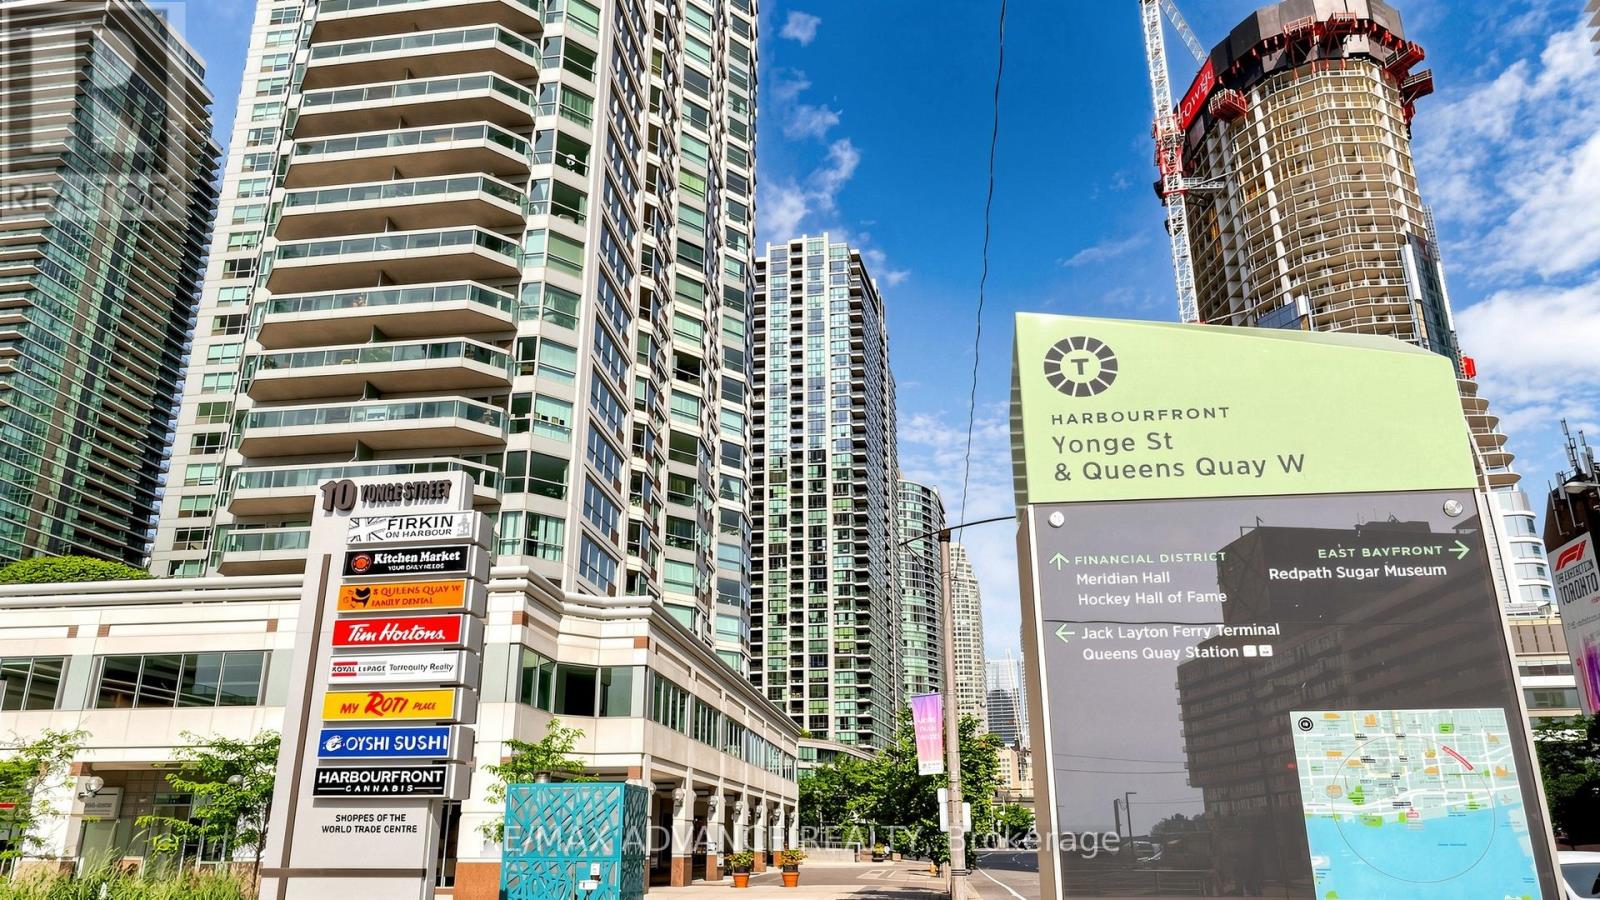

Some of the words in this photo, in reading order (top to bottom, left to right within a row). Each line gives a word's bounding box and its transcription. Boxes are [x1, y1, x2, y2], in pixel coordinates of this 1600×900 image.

[1051, 407, 1230, 425] HARBOURFRONT
[1052, 436, 1136, 456] Yonge
[1147, 432, 1174, 451] St
[1054, 463, 1072, 482] &
[1082, 461, 1185, 480] Queens
[1195, 456, 1266, 478] Quay
[1277, 454, 1305, 474] W
[320, 479, 357, 512] 10
[360, 482, 402, 503] YONGE
[403, 479, 452, 501] STREET
[387, 515, 454, 531] FIRKIN
[385, 531, 400, 539] ON
[402, 528, 452, 538] HARBOUR
[373, 552, 418, 565] Kitchen
[420, 550, 461, 563] Market
[1074, 554, 1155, 565] FINANCIAL
[1159, 551, 1227, 563] DISTRICT
[1317, 548, 1356, 559] EAST
[1361, 545, 1443, 557] BAYFRONT
[1076, 573, 1139, 585] Meridian
[1142, 571, 1170, 584] Hall
[1268, 566, 1333, 581] Redpath
[1336, 565, 1380, 580] Sugar
[1384, 564, 1448, 577] Museum
[381, 586, 420, 597] QUEENS
[422, 584, 449, 595] QUAY
[1559, 572, 1599, 604] TORONTO
[372, 598, 400, 607] FAMILY
[402, 597, 433, 606] DENTAL
[1078, 593, 1131, 607] Hockey
[1135, 592, 1164, 604] Hall
[1167, 592, 1183, 604] of
[1187, 590, 1228, 603] Fame
[348, 623, 377, 642] Tim
[1081, 626, 1114, 640] Jack
[1118, 625, 1169, 641] Layton
[1173, 625, 1212, 641] Ferry
[1216, 623, 1281, 637] Terminal
[1082, 649, 1138, 661] Queens
[1142, 648, 1181, 661] Quay
[1184, 645, 1239, 658] Station
[331, 665, 355, 673] ROYAL
[429, 662, 454, 673] Realty
[340, 702, 360, 714] MY
[364, 691, 409, 717] ROTI
[412, 702, 437, 711] PLACE
[346, 736, 390, 751] OYSHI
[393, 735, 448, 750] SUSHI
[318, 770, 444, 784] HARBOURFRONT
[345, 784, 414, 792] CANNABIS
[335, 813, 375, 822] SHOPPES
[376, 813, 388, 822] OF
[389, 813, 407, 822] THE
[321, 825, 352, 833] WORLD
[354, 825, 382, 833] TRADE
[383, 825, 418, 833] CENTRE
